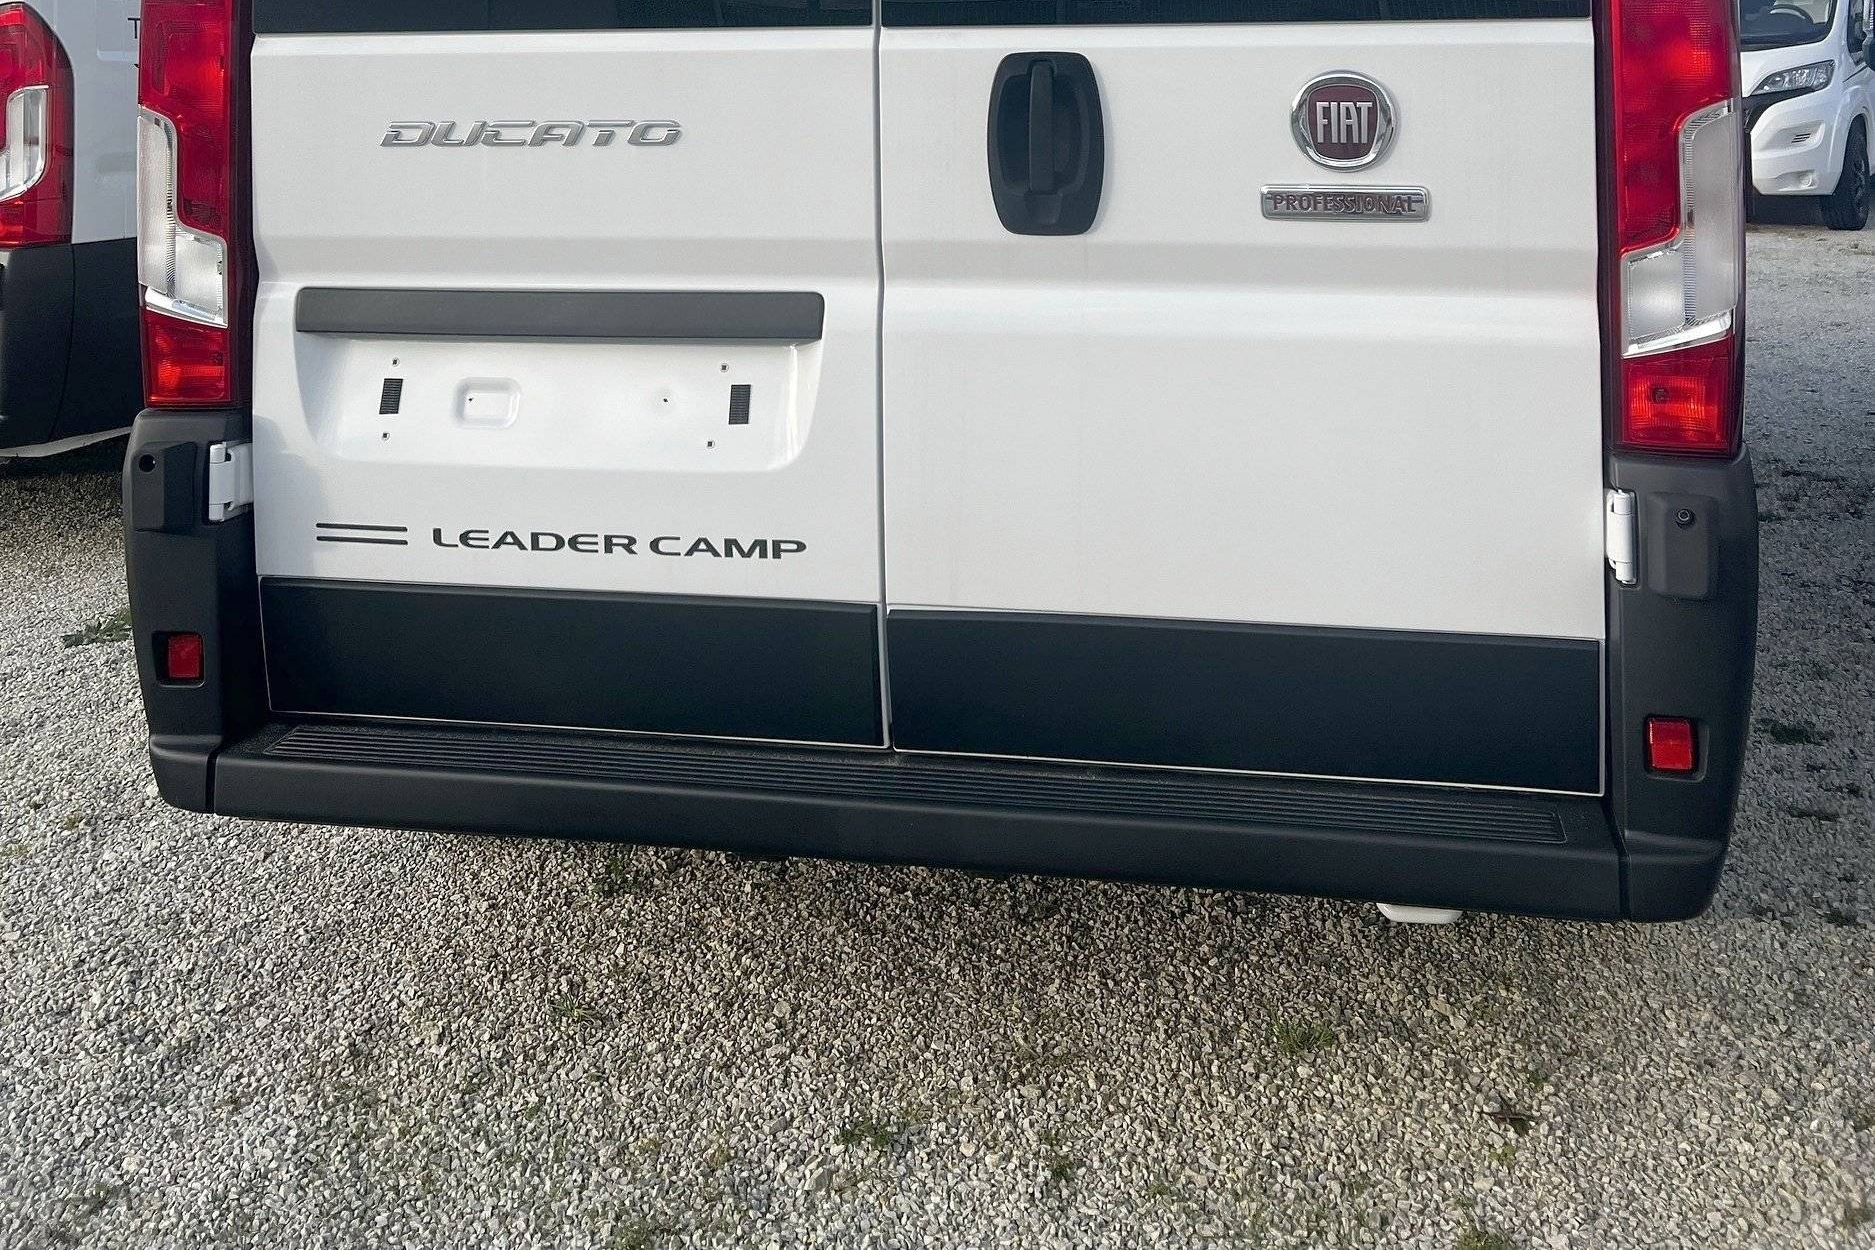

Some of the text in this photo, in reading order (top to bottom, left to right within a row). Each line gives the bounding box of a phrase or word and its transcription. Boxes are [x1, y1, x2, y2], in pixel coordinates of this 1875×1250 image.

[379, 120, 681, 147] DUCATO
[1315, 101, 1373, 144] FIAT
[1272, 193, 1418, 214] PROFESSIONAL
[432, 527, 808, 560] LEADER CAMP
